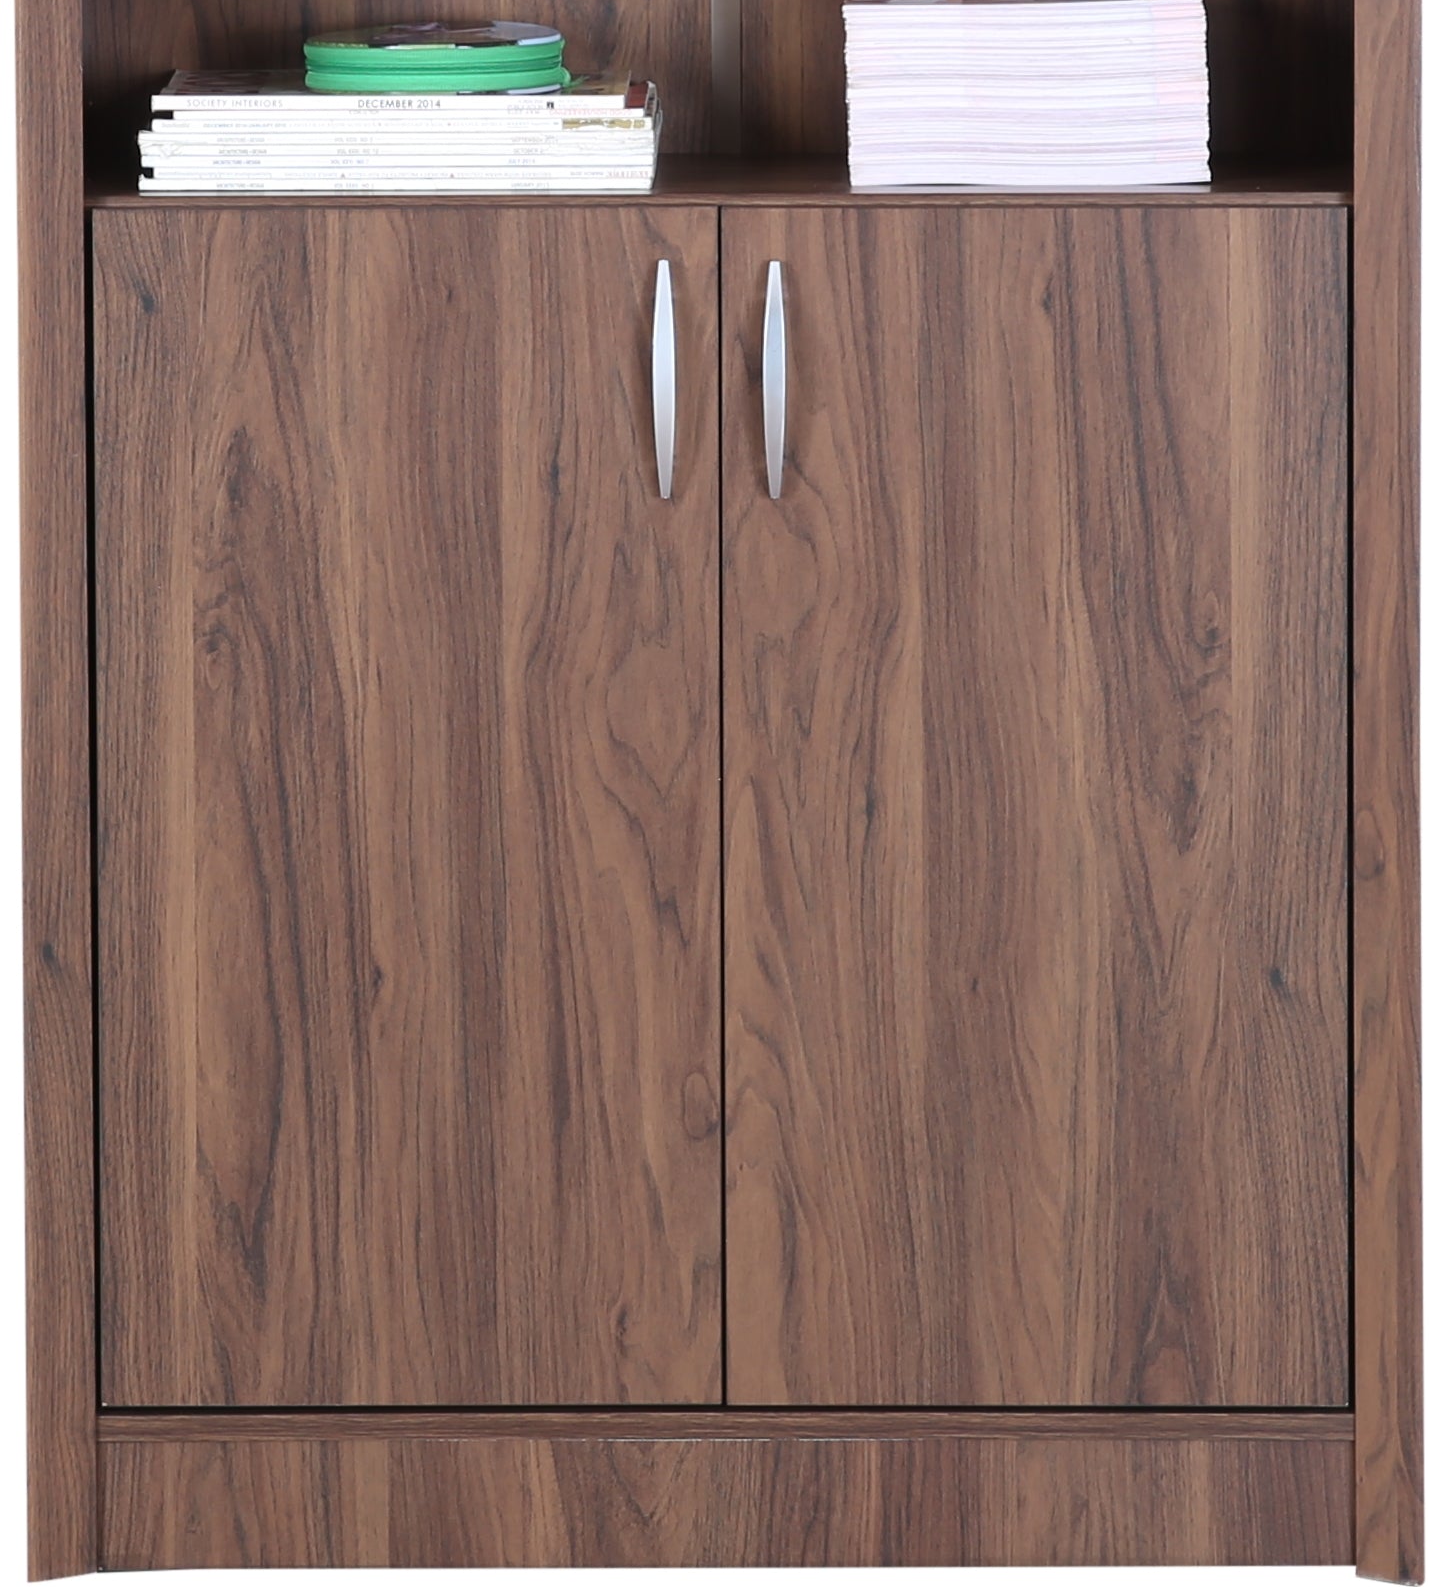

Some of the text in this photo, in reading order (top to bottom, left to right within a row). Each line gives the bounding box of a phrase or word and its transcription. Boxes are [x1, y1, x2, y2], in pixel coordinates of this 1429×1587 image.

[186, 98, 283, 109] SOCIETY INTERIORS
[357, 99, 441, 109] DECEMBER 2014
